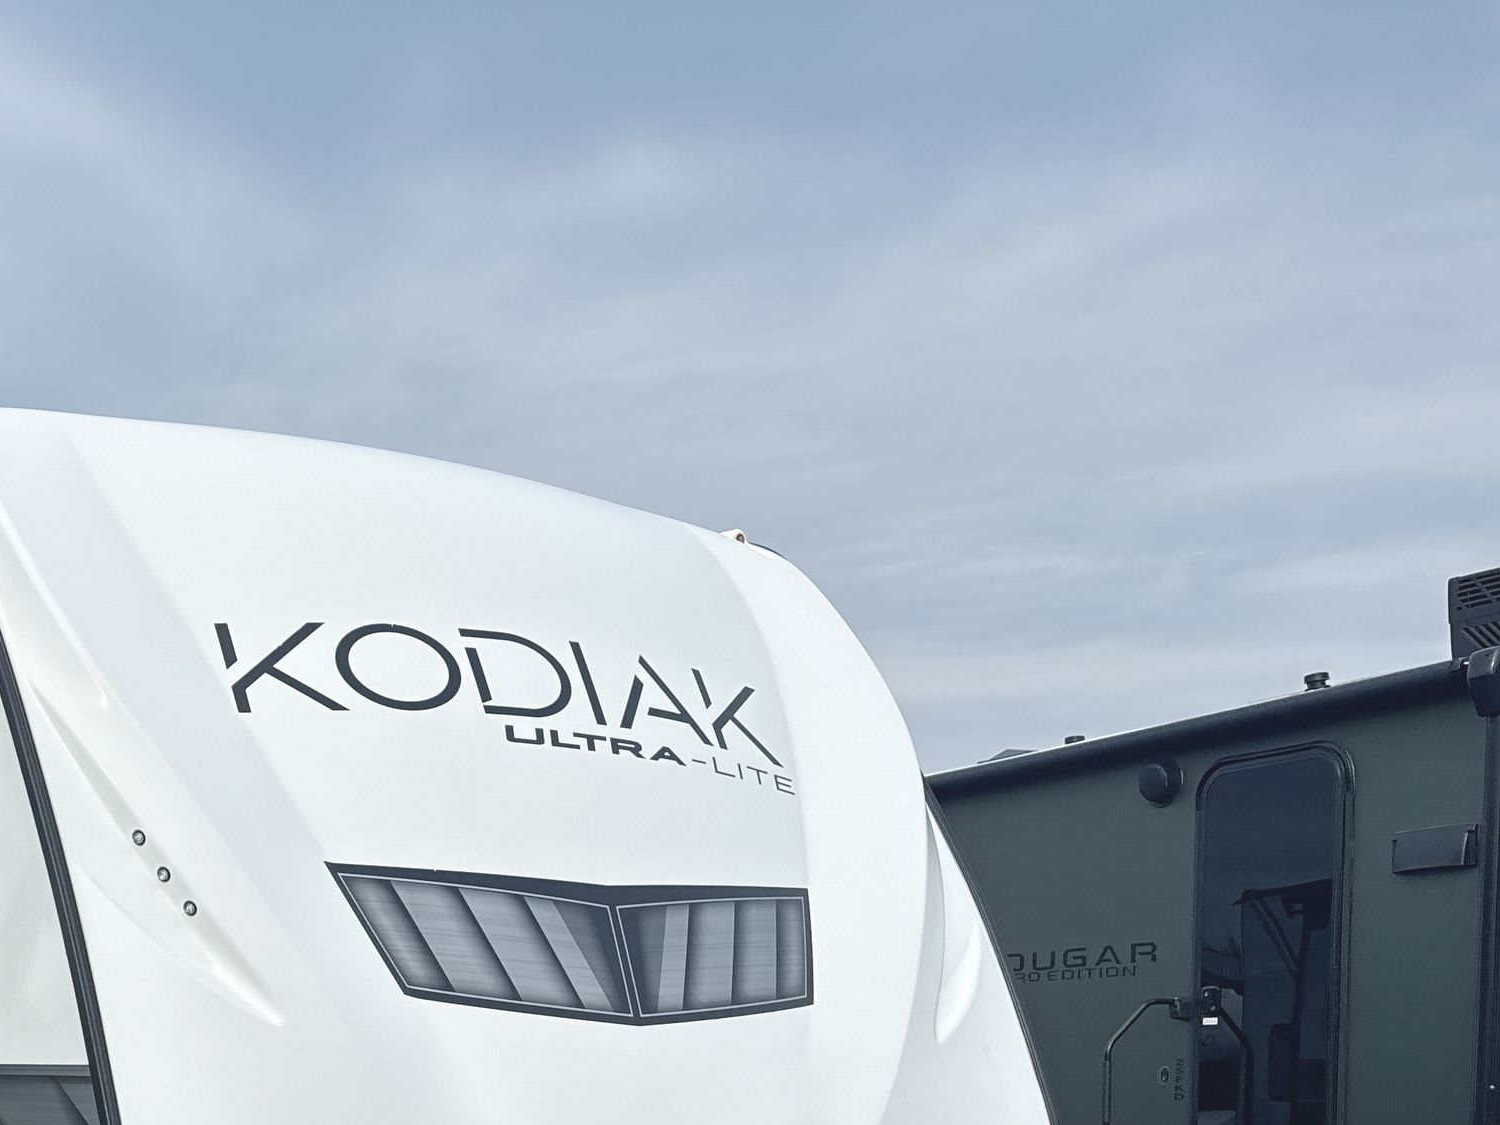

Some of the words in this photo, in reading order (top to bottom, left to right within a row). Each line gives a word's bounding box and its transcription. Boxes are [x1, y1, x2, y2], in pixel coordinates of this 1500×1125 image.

[214, 622, 785, 768] KODIAK
[505, 724, 796, 796] ULTRA-LITE
[1007, 942, 1158, 973] OUGAR
[1048, 966, 1137, 981] EDITION
